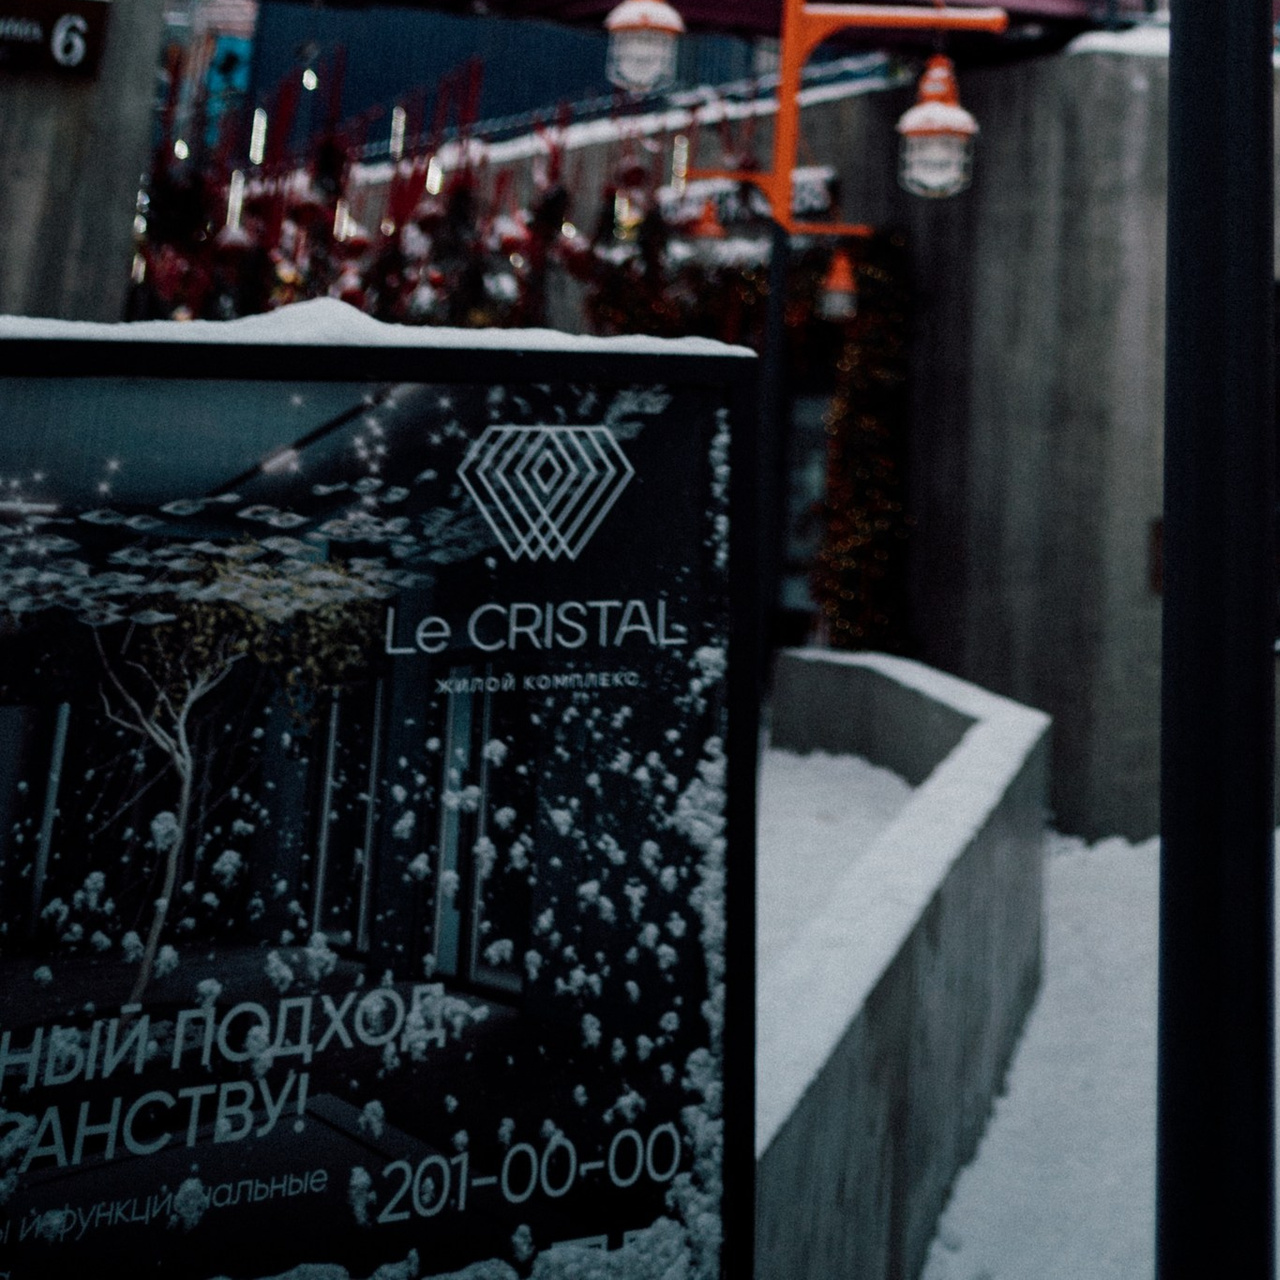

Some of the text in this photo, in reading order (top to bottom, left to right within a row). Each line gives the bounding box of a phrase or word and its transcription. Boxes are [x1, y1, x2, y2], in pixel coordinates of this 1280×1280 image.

[50, 13, 90, 67] 6
[385, 599, 687, 654] Le CRISTAL
[171, 982, 447, 1070] ПОДХОД
[50, 1168, 329, 1243] функцинальные
[377, 1122, 683, 1224] 201-00-00
